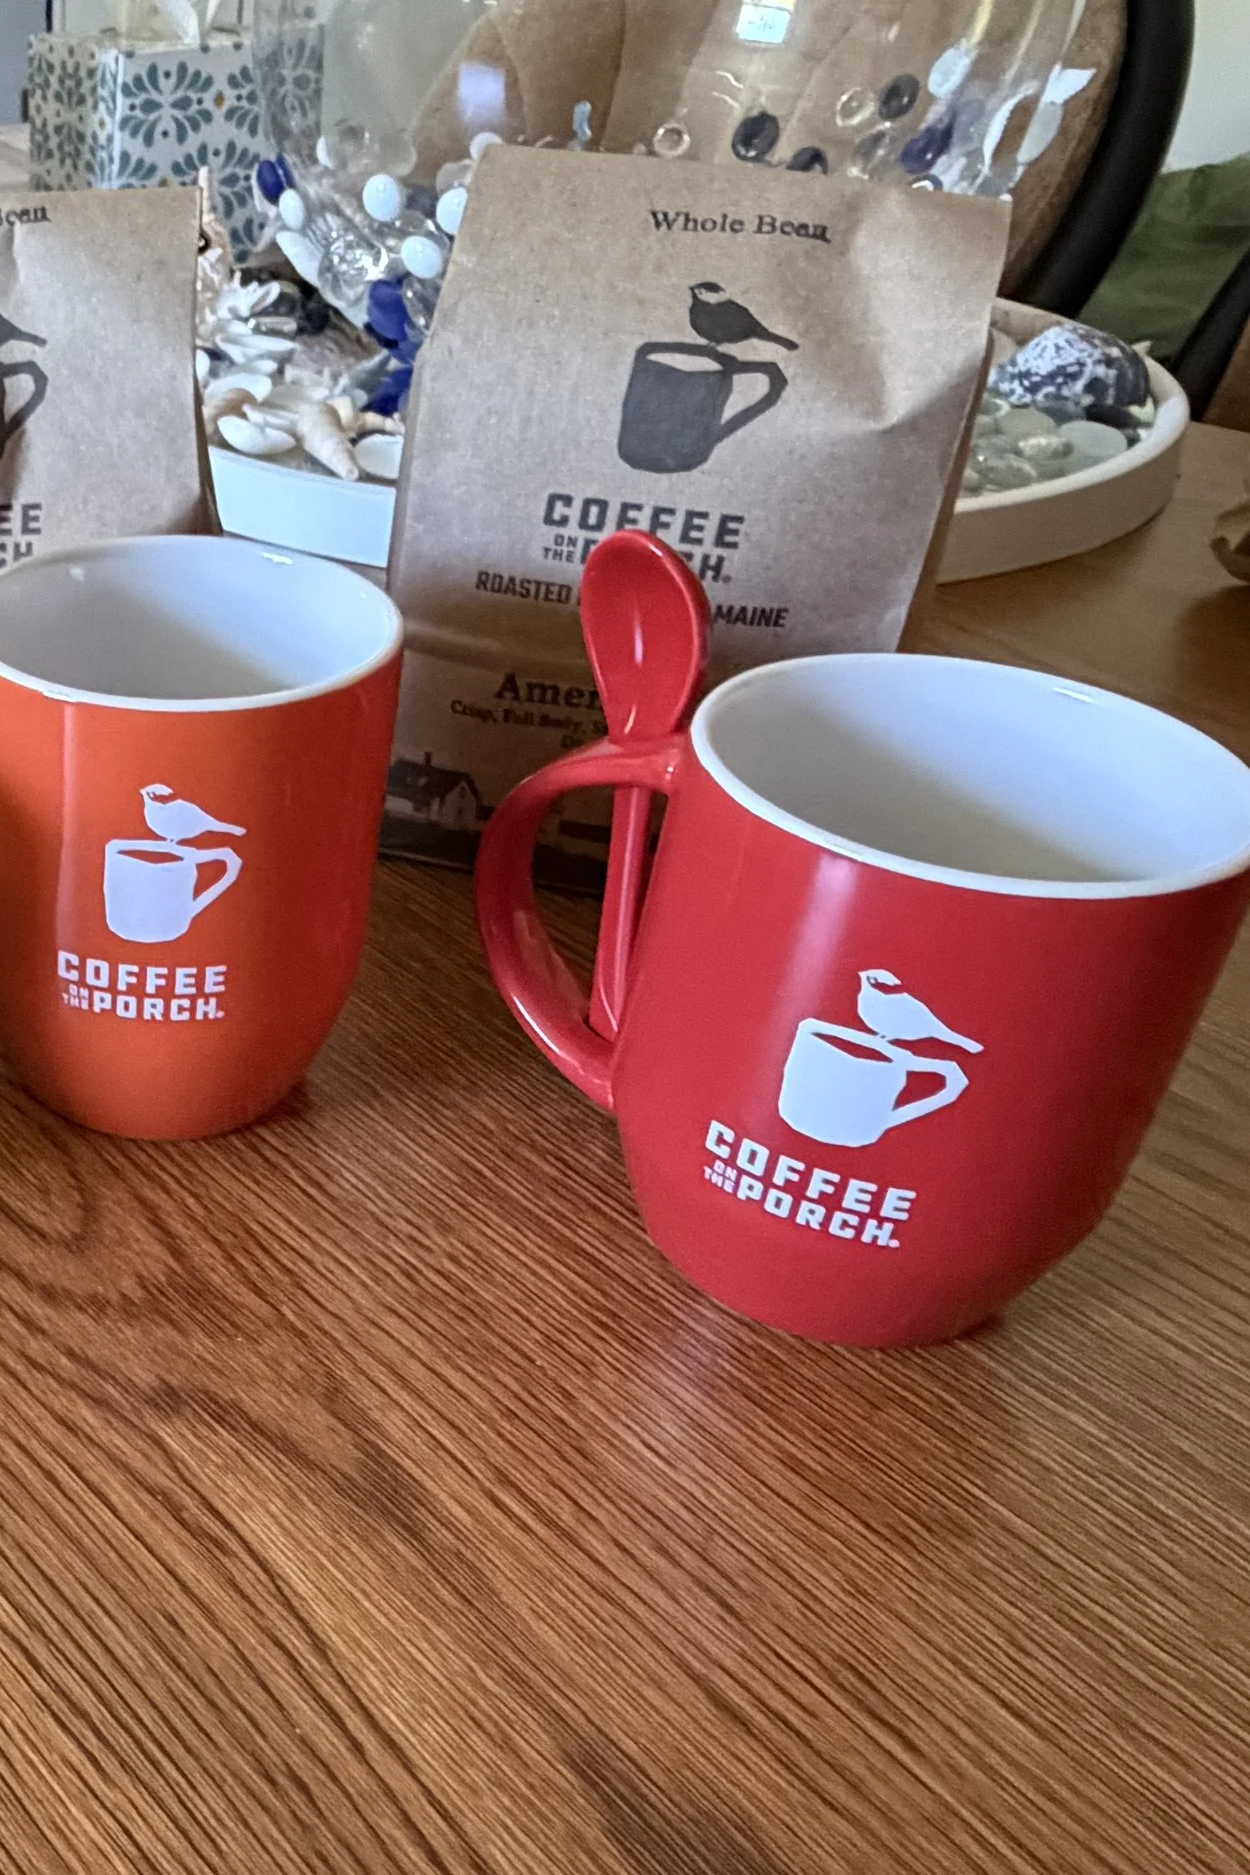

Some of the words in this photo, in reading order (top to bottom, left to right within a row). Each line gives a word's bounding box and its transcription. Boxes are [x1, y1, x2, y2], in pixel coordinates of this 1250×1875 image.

[650, 210, 745, 234] Whole
[752, 214, 831, 243] Bean
[543, 493, 745, 549] COFFEE
[543, 547, 575, 564] THE
[553, 533, 578, 547] ON
[475, 569, 573, 605] ROASTED
[713, 603, 789, 628] MAINE
[495, 672, 603, 710] Amer
[57, 950, 228, 996] COFFEE
[703, 1165, 736, 1194] THE
[705, 1119, 918, 1221] COFFEE
[713, 1159, 738, 1181] ON
